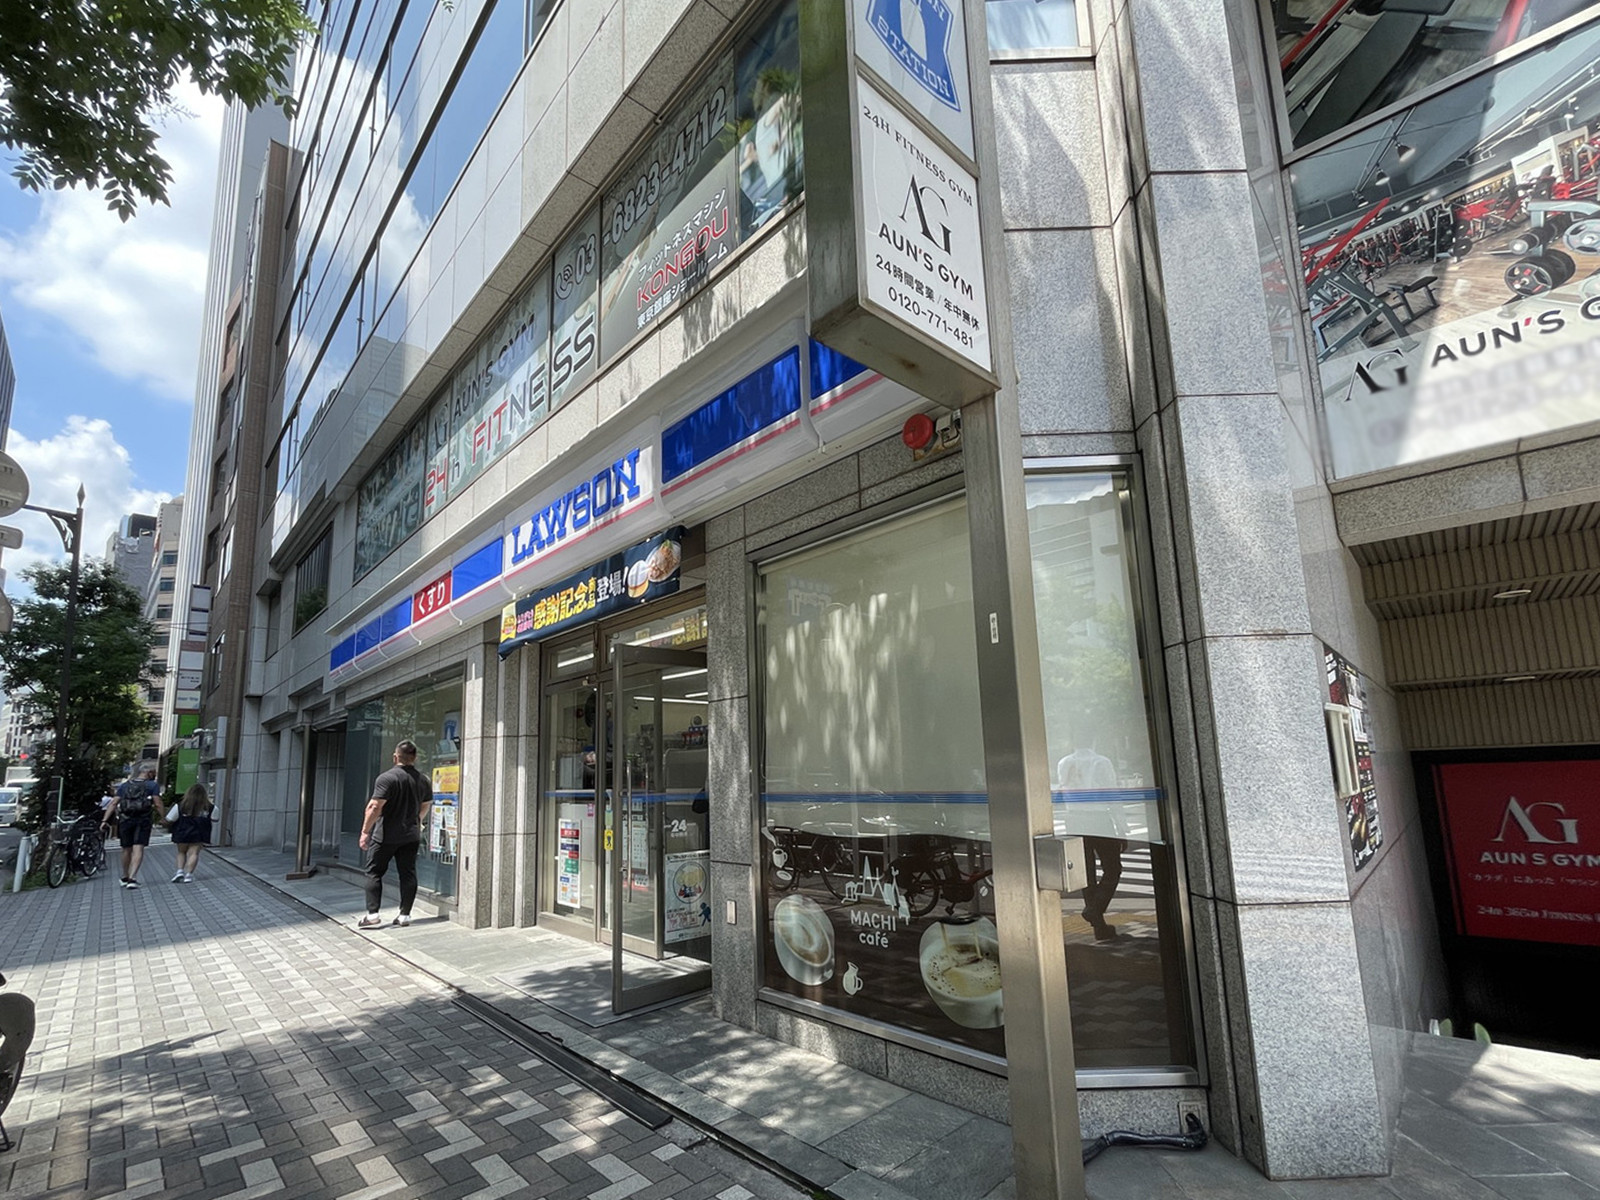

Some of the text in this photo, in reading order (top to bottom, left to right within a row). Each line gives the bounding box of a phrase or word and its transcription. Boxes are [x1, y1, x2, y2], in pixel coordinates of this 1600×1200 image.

[876, 15, 950, 97] STATION
[863, 105, 973, 207] 24H FITNESS GYM
[636, 206, 728, 310] KONGOU
[638, 188, 727, 282] フィットネスマシン
[878, 222, 974, 301] AUN'S GYM
[636, 243, 728, 330] 東京銀座ショールーム
[888, 286, 974, 349] 0120-771-481
[1431, 309, 1565, 368] AUN'S
[453, 361, 494, 420] AUN'S
[472, 314, 595, 465] FITNESS
[512, 448, 640, 564] LAWSON
[418, 581, 446, 615] くすり
[670, 819, 688, 833] 24
[1552, 854, 1600, 868] GYM
[850, 909, 897, 932] MACHI
[859, 931, 889, 948] café
